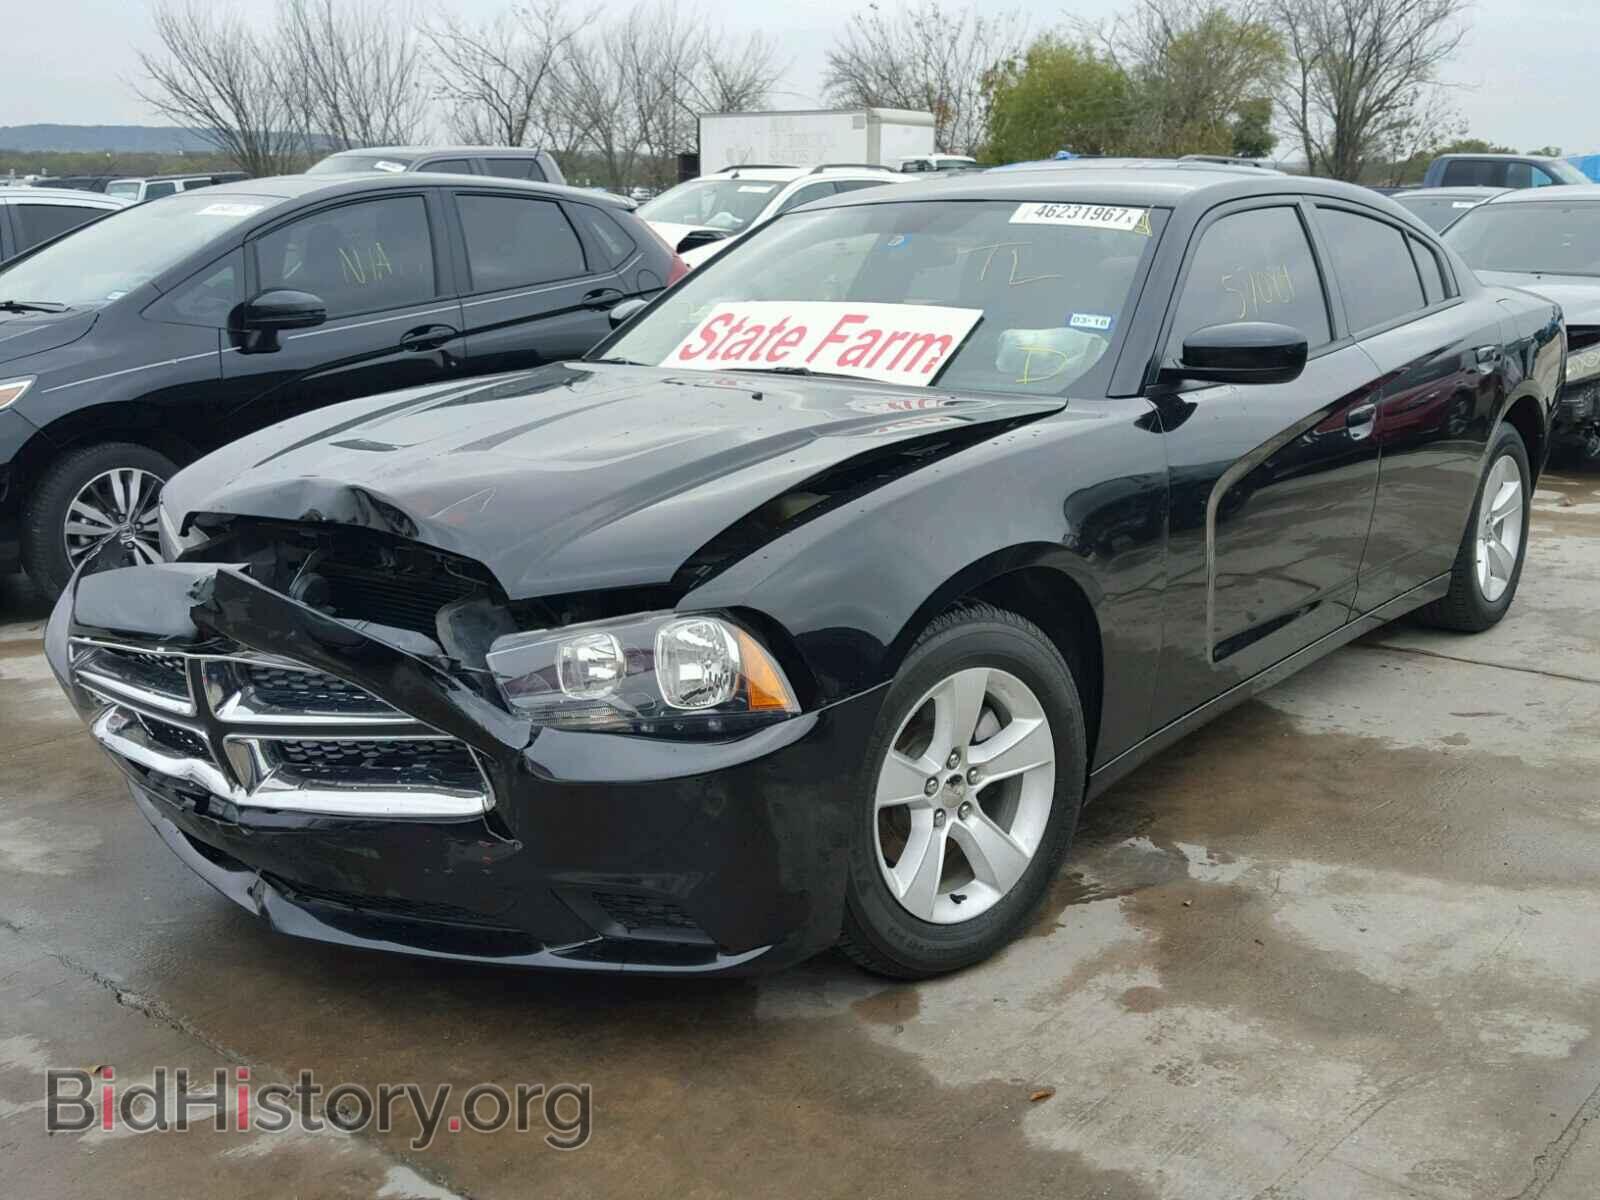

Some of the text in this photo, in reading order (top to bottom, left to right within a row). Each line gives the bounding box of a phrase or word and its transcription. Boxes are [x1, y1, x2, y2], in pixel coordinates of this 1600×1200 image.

[1034, 205, 1129, 222] 46231967
[678, 311, 954, 375] State Farm
